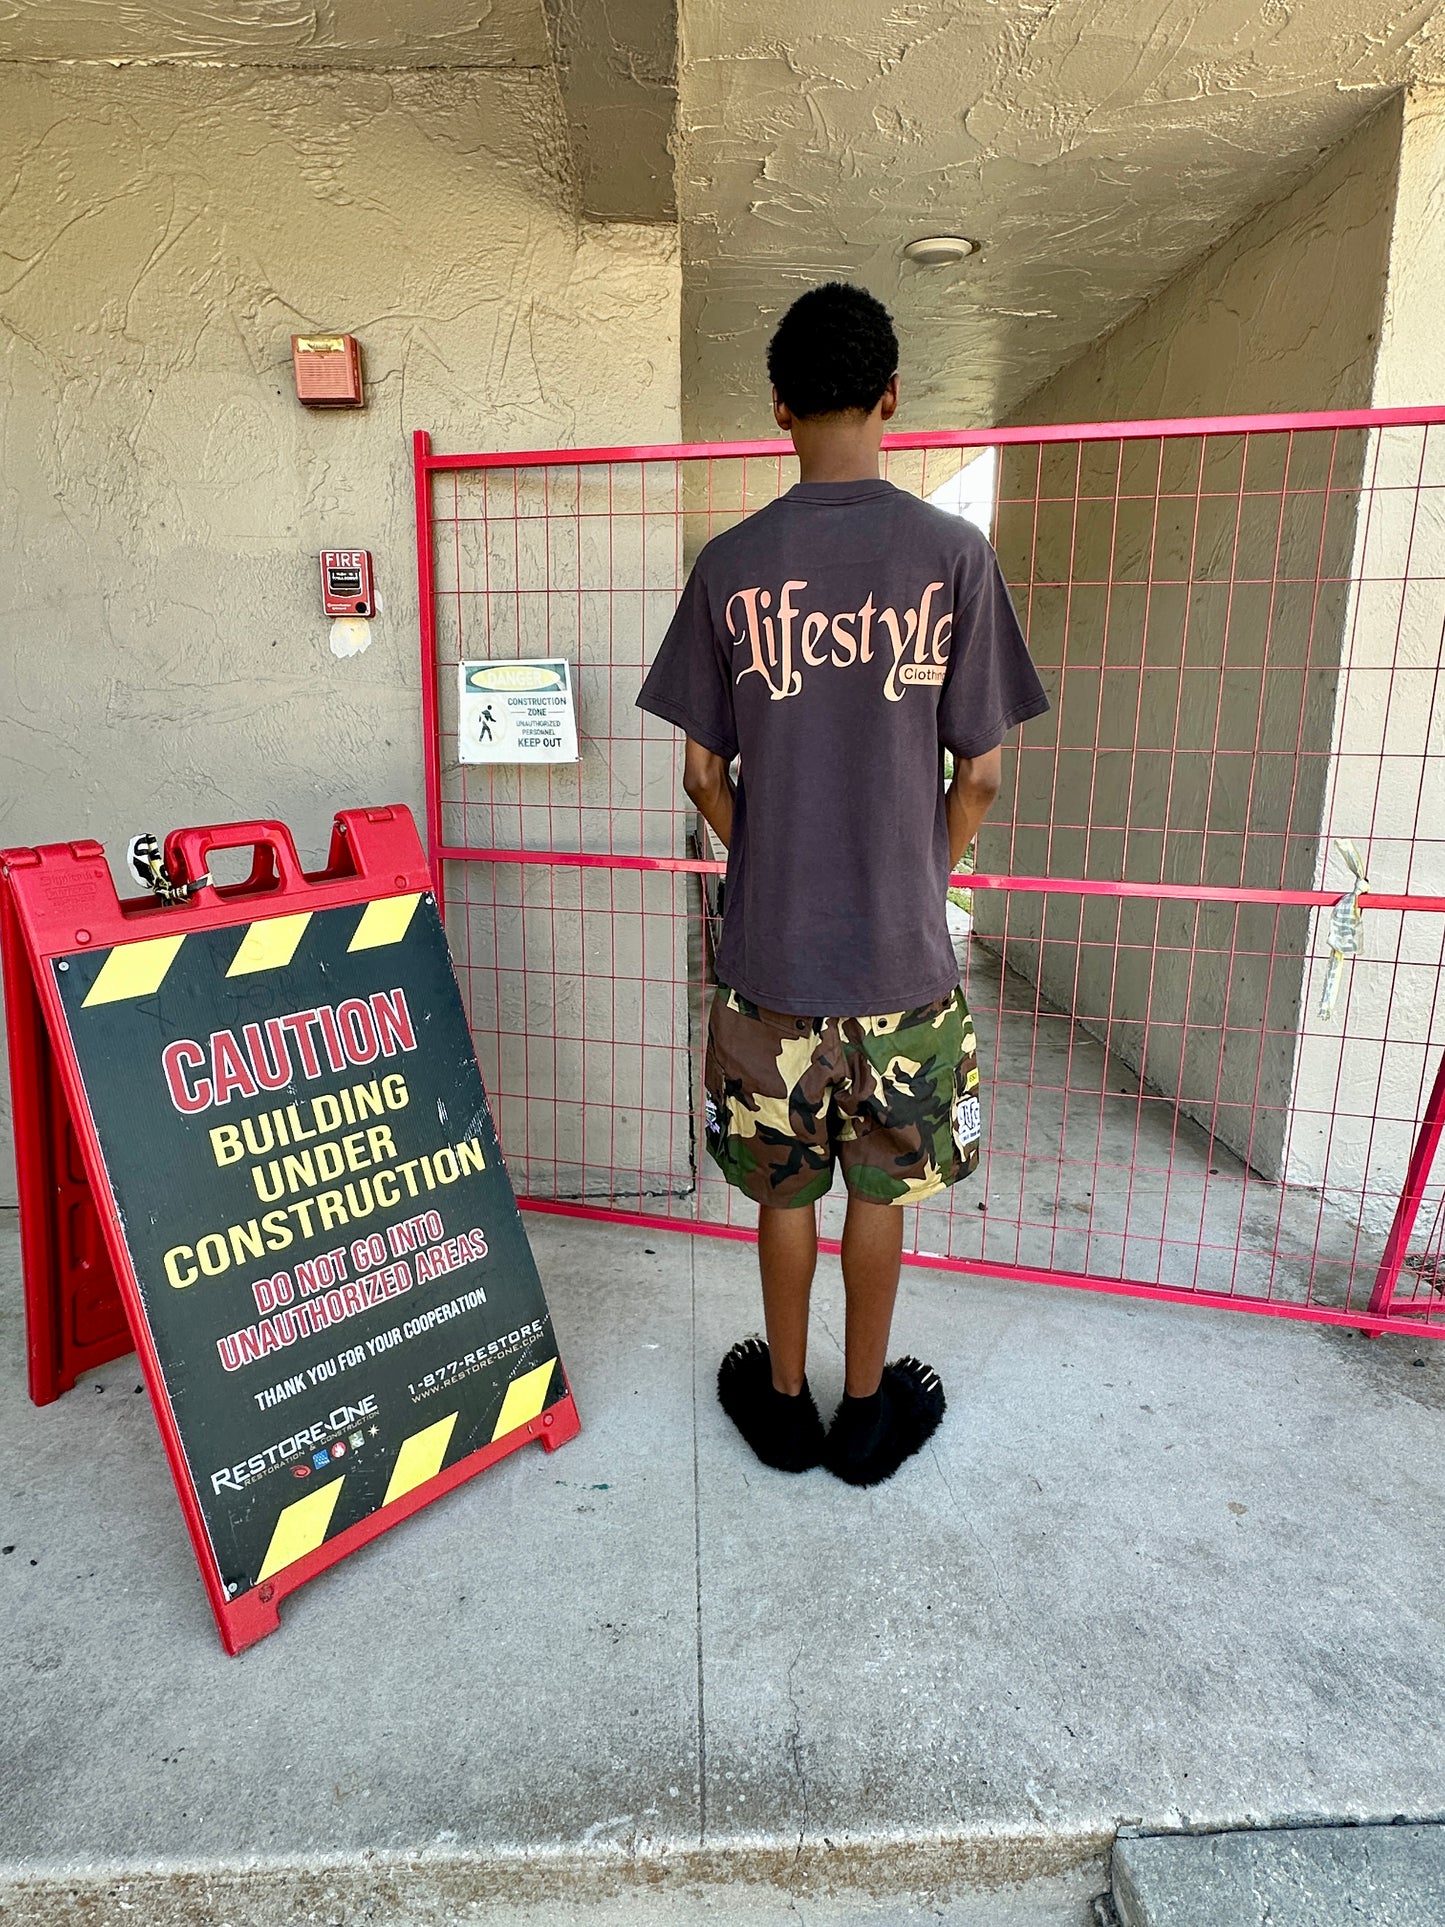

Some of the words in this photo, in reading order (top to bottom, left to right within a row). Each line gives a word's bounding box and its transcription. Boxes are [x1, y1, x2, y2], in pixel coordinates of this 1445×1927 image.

[325, 553, 361, 567] FIRE
[487, 671, 543, 687] DANGER
[726, 580, 953, 702] Lifestyle
[507, 697, 567, 706] CONSTRUCTION
[527, 708, 547, 716] ZONE
[518, 738, 541, 747] KEEP
[543, 738, 562, 747] OUT
[161, 987, 417, 1115] CAUTION
[208, 1073, 410, 1168] BUILDING
[251, 1124, 398, 1202] UNDER
[163, 1137, 487, 1290] CONSTRUCTION
[217, 1260, 413, 1372] UNAUTHORIZED
[415, 1227, 489, 1287] AREAS
[252, 1271, 294, 1316] DO
[294, 1246, 348, 1298] NOT
[350, 1232, 387, 1273] GO
[386, 1210, 444, 1258] INTO
[254, 1372, 308, 1411] THANK
[307, 1360, 338, 1387] YOU
[338, 1344, 367, 1373] FOR
[365, 1328, 403, 1359] YOUR
[403, 1287, 487, 1339] COOPERATION
[407, 1319, 543, 1395] 1-877-RESTORE
[411, 1331, 545, 1404] WWW.RESTORE-ONE.COM
[243, 1450, 307, 1487] RESTORATION
[320, 1411, 380, 1445] CONSTRUCTION
